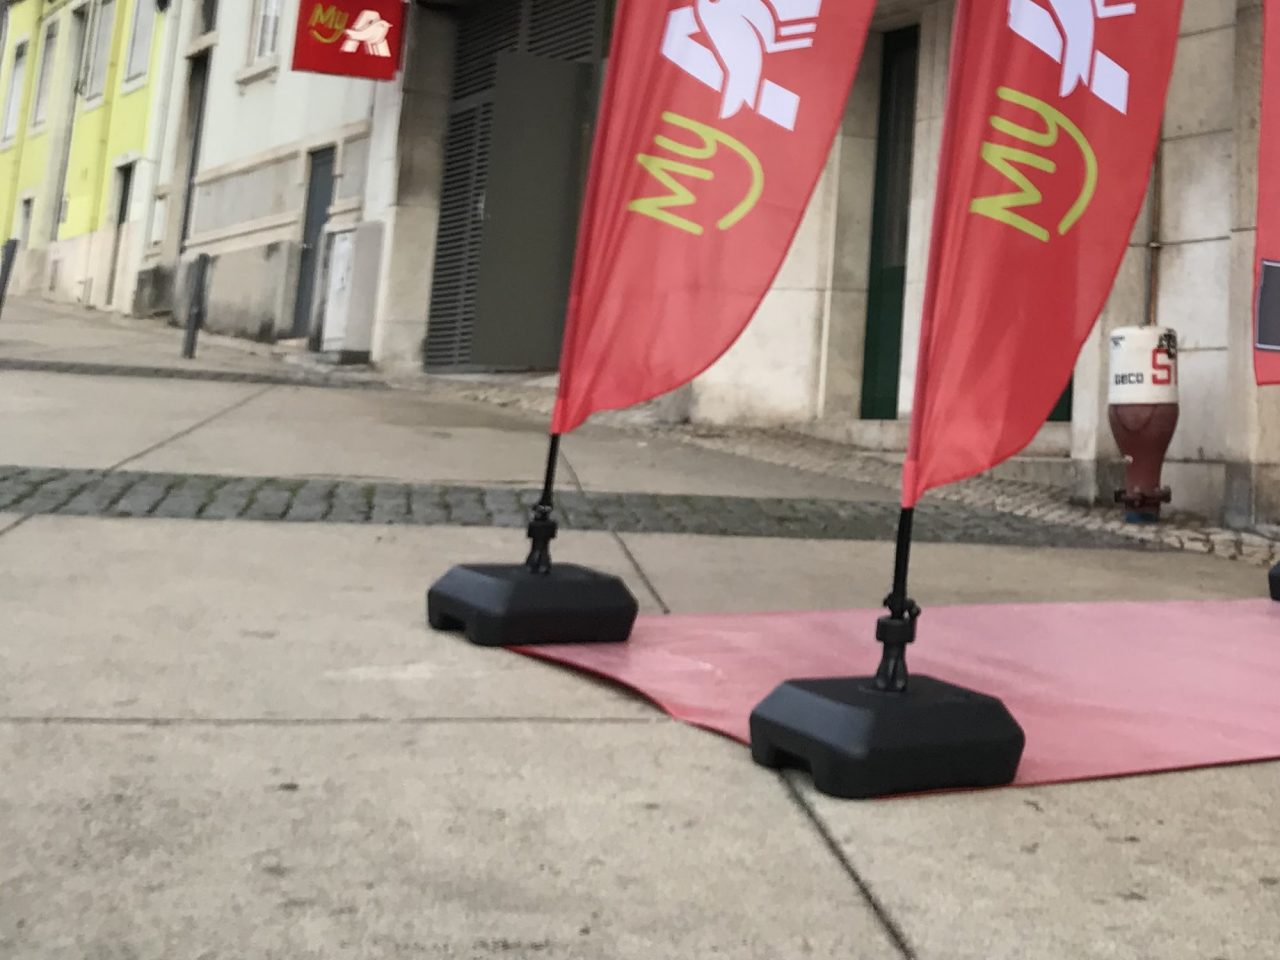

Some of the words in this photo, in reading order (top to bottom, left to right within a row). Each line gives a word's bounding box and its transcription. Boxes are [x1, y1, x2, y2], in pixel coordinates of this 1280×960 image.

[306, 3, 350, 44] My
[627, 111, 764, 236] My
[970, 86, 1098, 242] My
